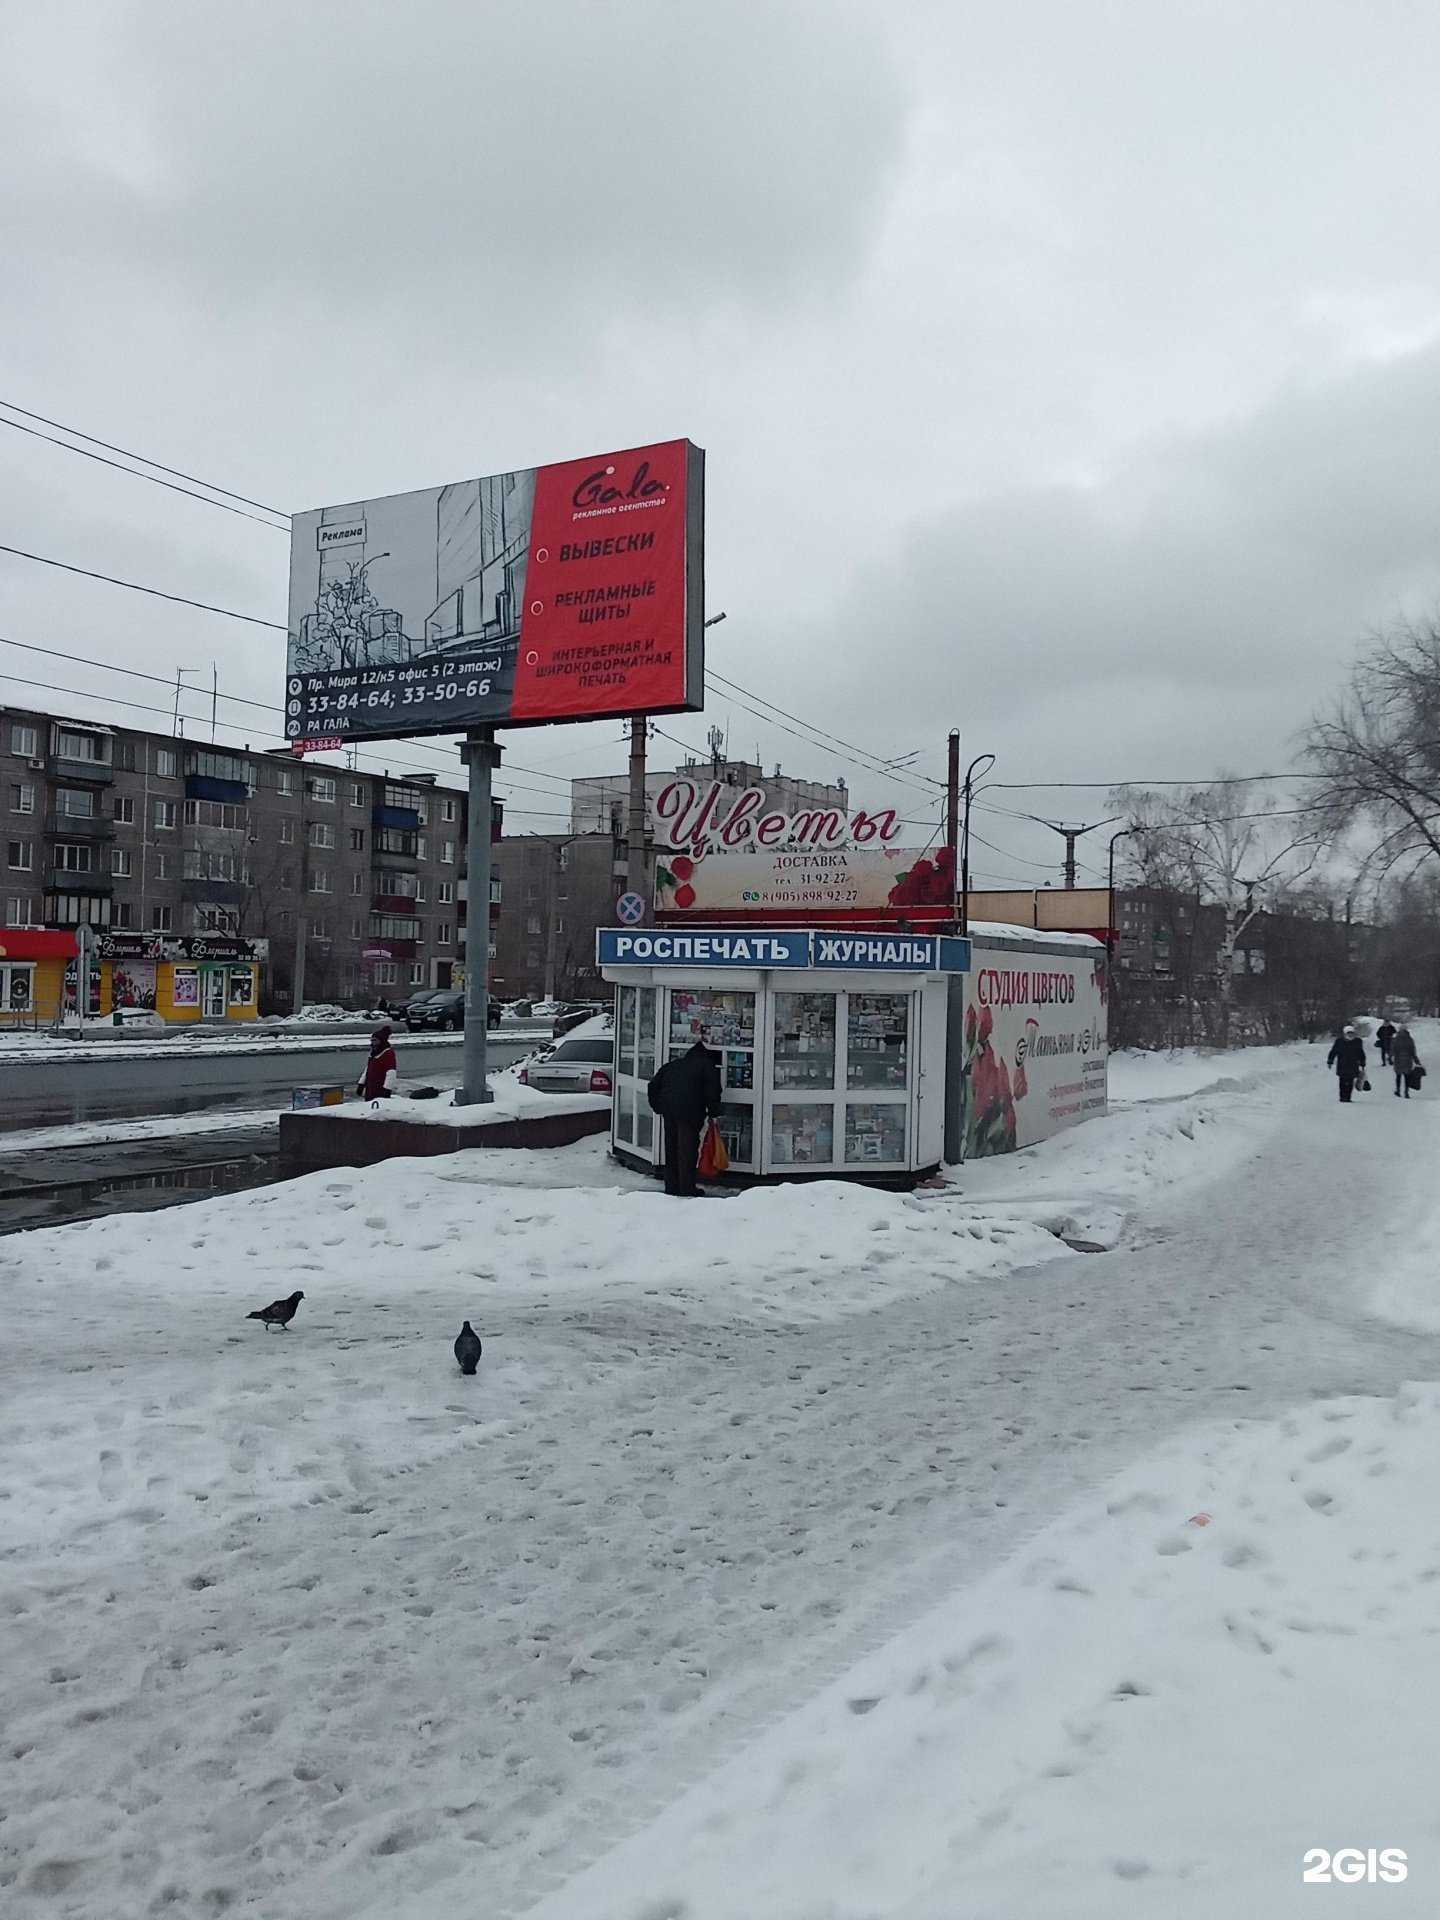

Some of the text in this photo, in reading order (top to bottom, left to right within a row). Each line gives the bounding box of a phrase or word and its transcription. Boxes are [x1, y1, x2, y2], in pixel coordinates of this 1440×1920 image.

[573, 462, 666, 508] Gala
[572, 498, 666, 521] рекламное агентство
[321, 525, 363, 543] Реклама
[560, 532, 654, 562] ВЫВЕСКИ
[555, 580, 656, 607] РЕКЛАМНЫЕ
[578, 604, 631, 624] ЩИТЫ
[552, 639, 655, 661] ИНТЕРЬЕРНАЯ И
[307, 678, 325, 692] Пр.
[328, 675, 358, 689] Мира
[399, 669, 428, 684] офис
[431, 664, 440, 677] 5
[442, 664, 455, 678] (2
[458, 657, 502, 675] этаж)
[535, 651, 672, 678] ШИРОКОФОРМАТНАЯ
[578, 673, 626, 688] ПЕЧАТЬ
[307, 679, 492, 714] 33-84-64; 33-50-66
[307, 717, 350, 732] РА ГАЛА
[305, 739, 342, 751] 33-84-64
[656, 780, 901, 860] Цветы
[773, 855, 848, 869] ДОСТАВКА
[800, 873, 847, 885] 31-92-27
[617, 937, 790, 960] РОСПЕЧАТЬ
[819, 940, 931, 964] ЖУРНАЛЫ
[978, 969, 1075, 1010] СТУДИЯ ЦВЕТОВ
